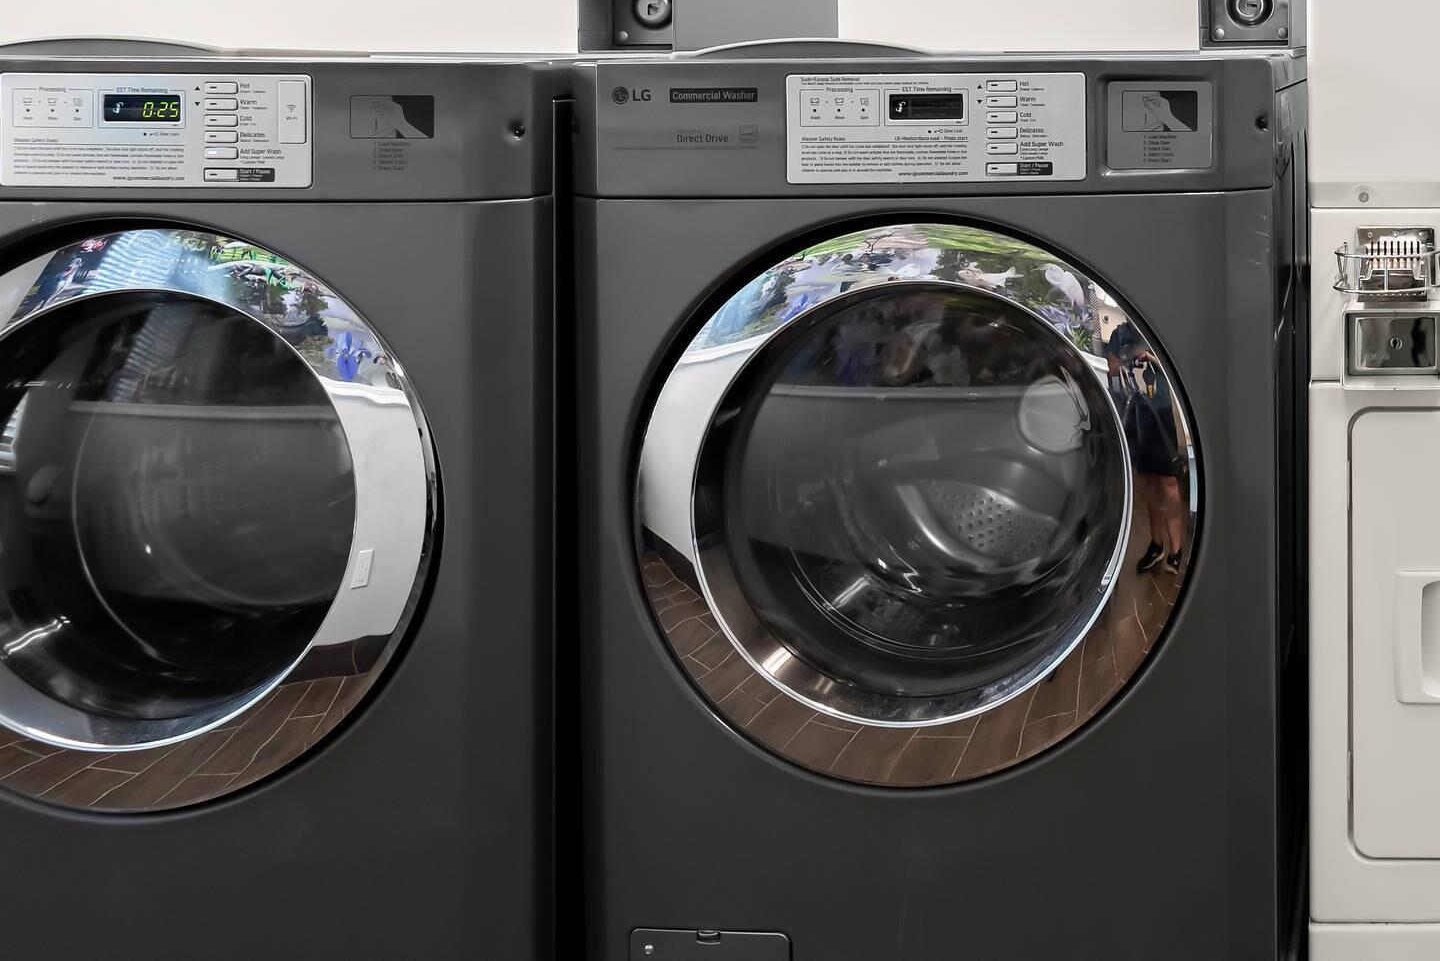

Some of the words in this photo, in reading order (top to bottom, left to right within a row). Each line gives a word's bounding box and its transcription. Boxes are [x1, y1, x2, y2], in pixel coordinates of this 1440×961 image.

[632, 89, 651, 101] LG
[672, 91, 721, 101] Commercial
[722, 91, 755, 100] Washer
[676, 134, 703, 143] Direct
[705, 134, 729, 143] Drive
[251, 148, 265, 156] Super
